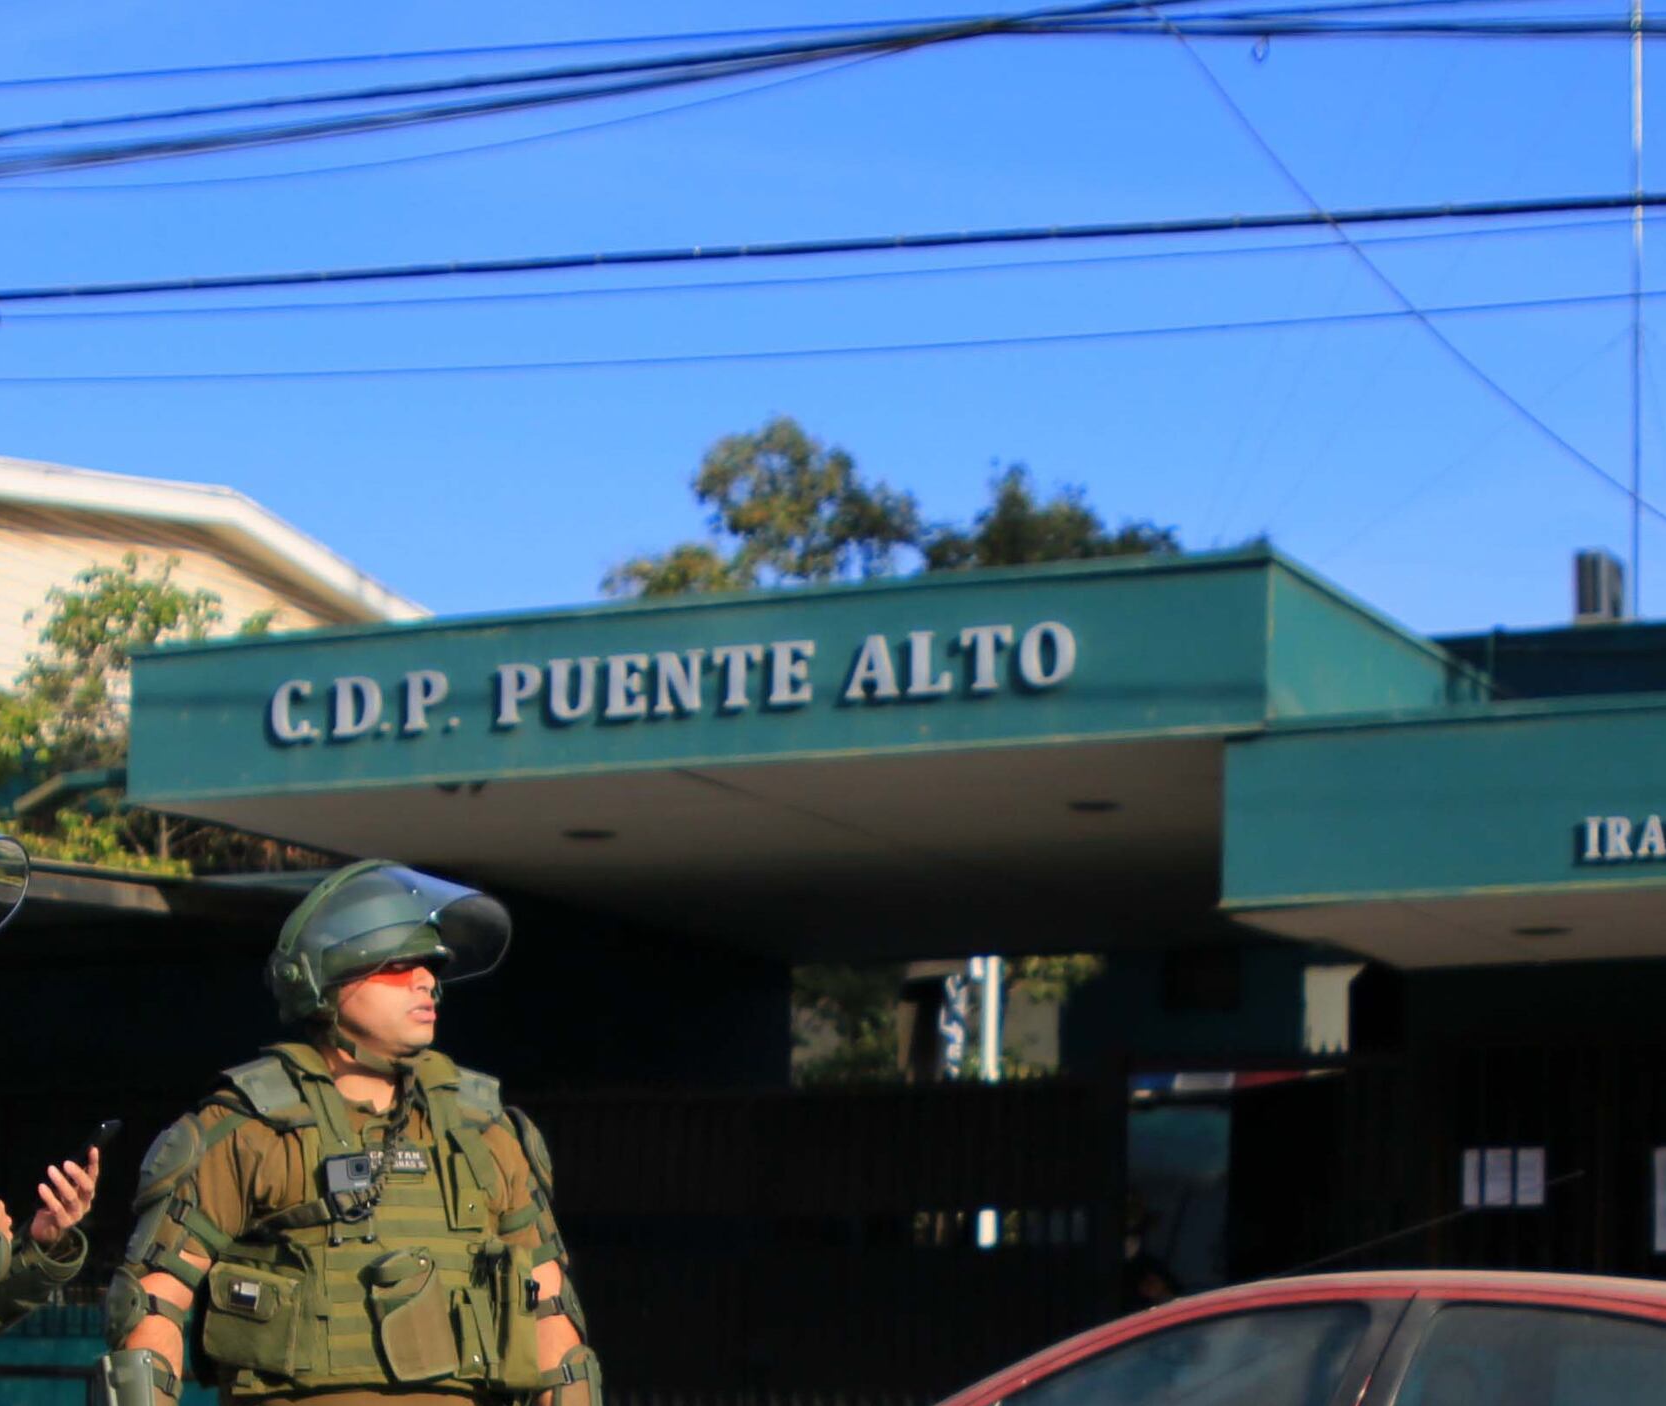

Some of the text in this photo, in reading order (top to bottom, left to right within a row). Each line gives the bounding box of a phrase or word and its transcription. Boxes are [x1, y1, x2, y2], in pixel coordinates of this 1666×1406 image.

[270, 620, 1077, 743] C.D.P. PUENTE ALTO
